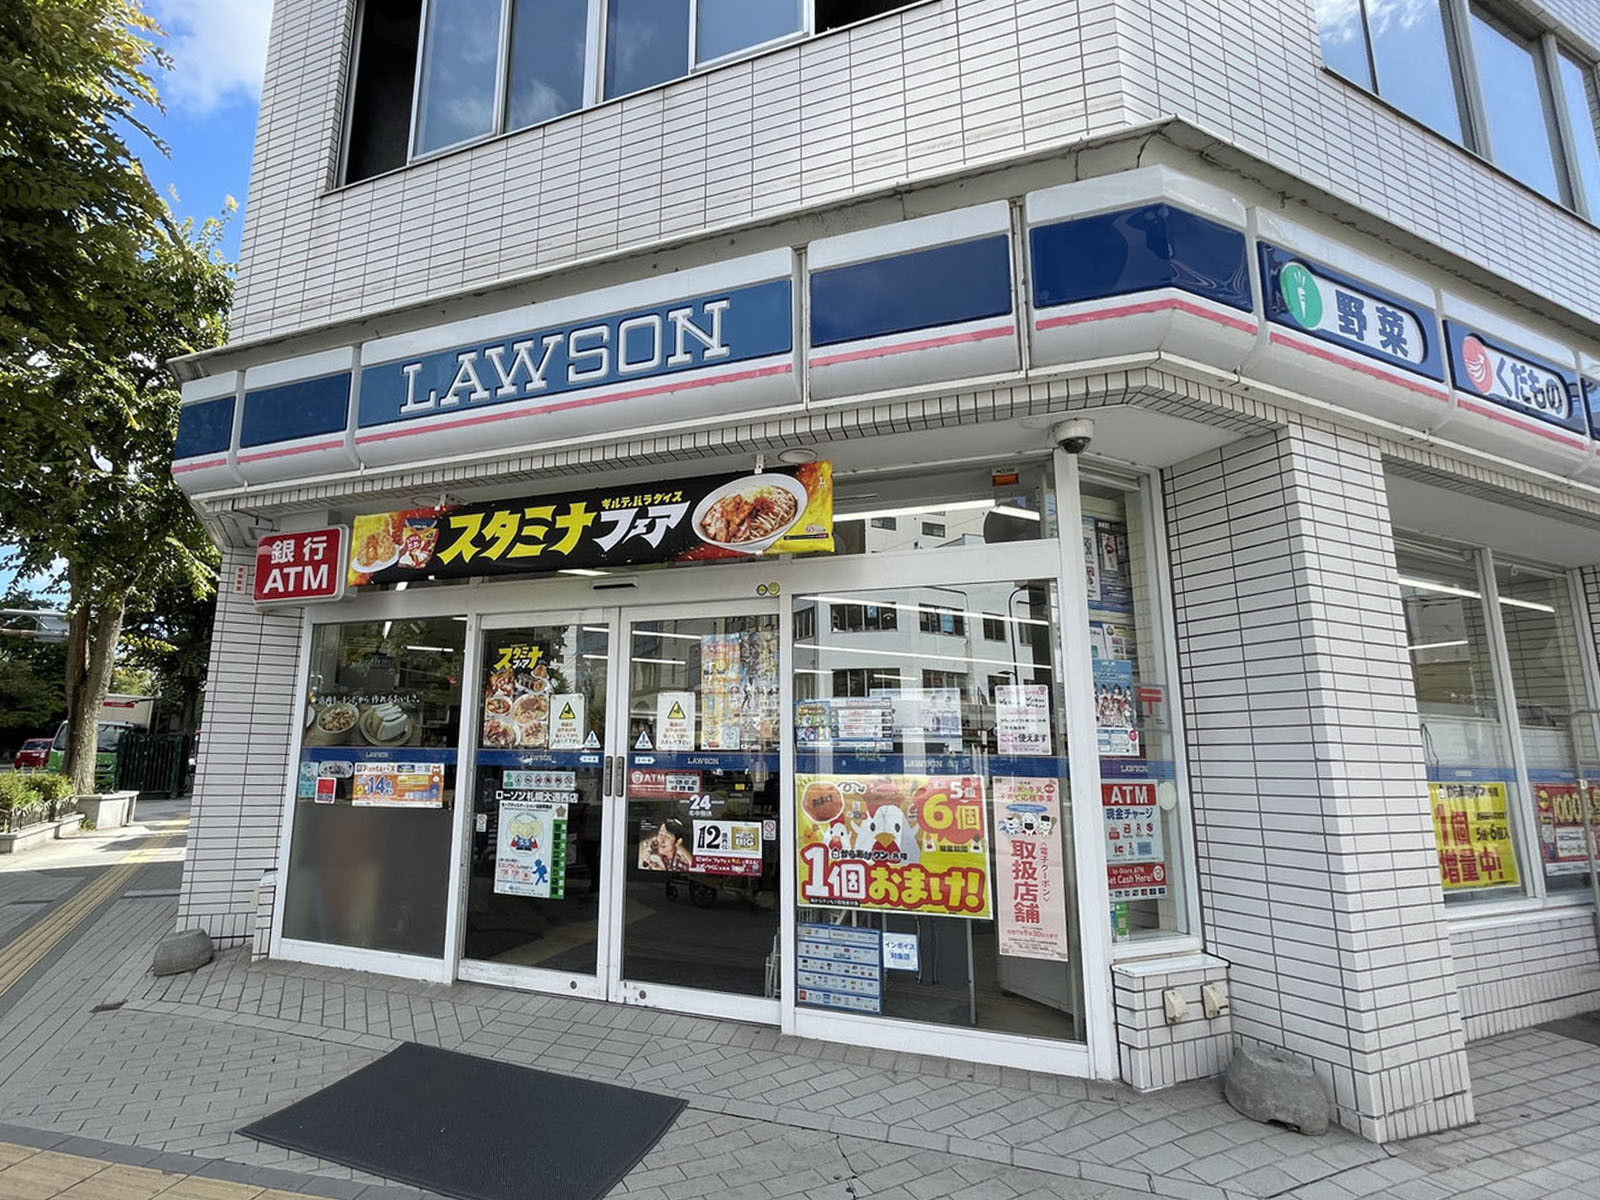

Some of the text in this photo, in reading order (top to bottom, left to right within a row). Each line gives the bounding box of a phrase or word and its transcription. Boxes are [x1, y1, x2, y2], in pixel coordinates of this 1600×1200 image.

[1335, 289, 1409, 358] 野菜
[400, 298, 731, 414] LAWSON
[1496, 357, 1562, 414] くだもの
[270, 536, 328, 565] 銀行
[262, 564, 329, 594] ATM
[494, 646, 544, 670] スタミナ
[687, 757, 720, 765] LAWSON
[904, 760, 943, 768] LAWSON
[643, 773, 665, 783] ATM
[689, 794, 711, 810] 24
[1110, 785, 1148, 804] ATM
[923, 793, 981, 830] 6個
[1105, 808, 1154, 820] 現金チャージ
[697, 825, 721, 849] 12
[1440, 847, 1504, 884] 増量中!
[1011, 839, 1040, 924] 取扱店舗
[1117, 875, 1134, 884] Cash
